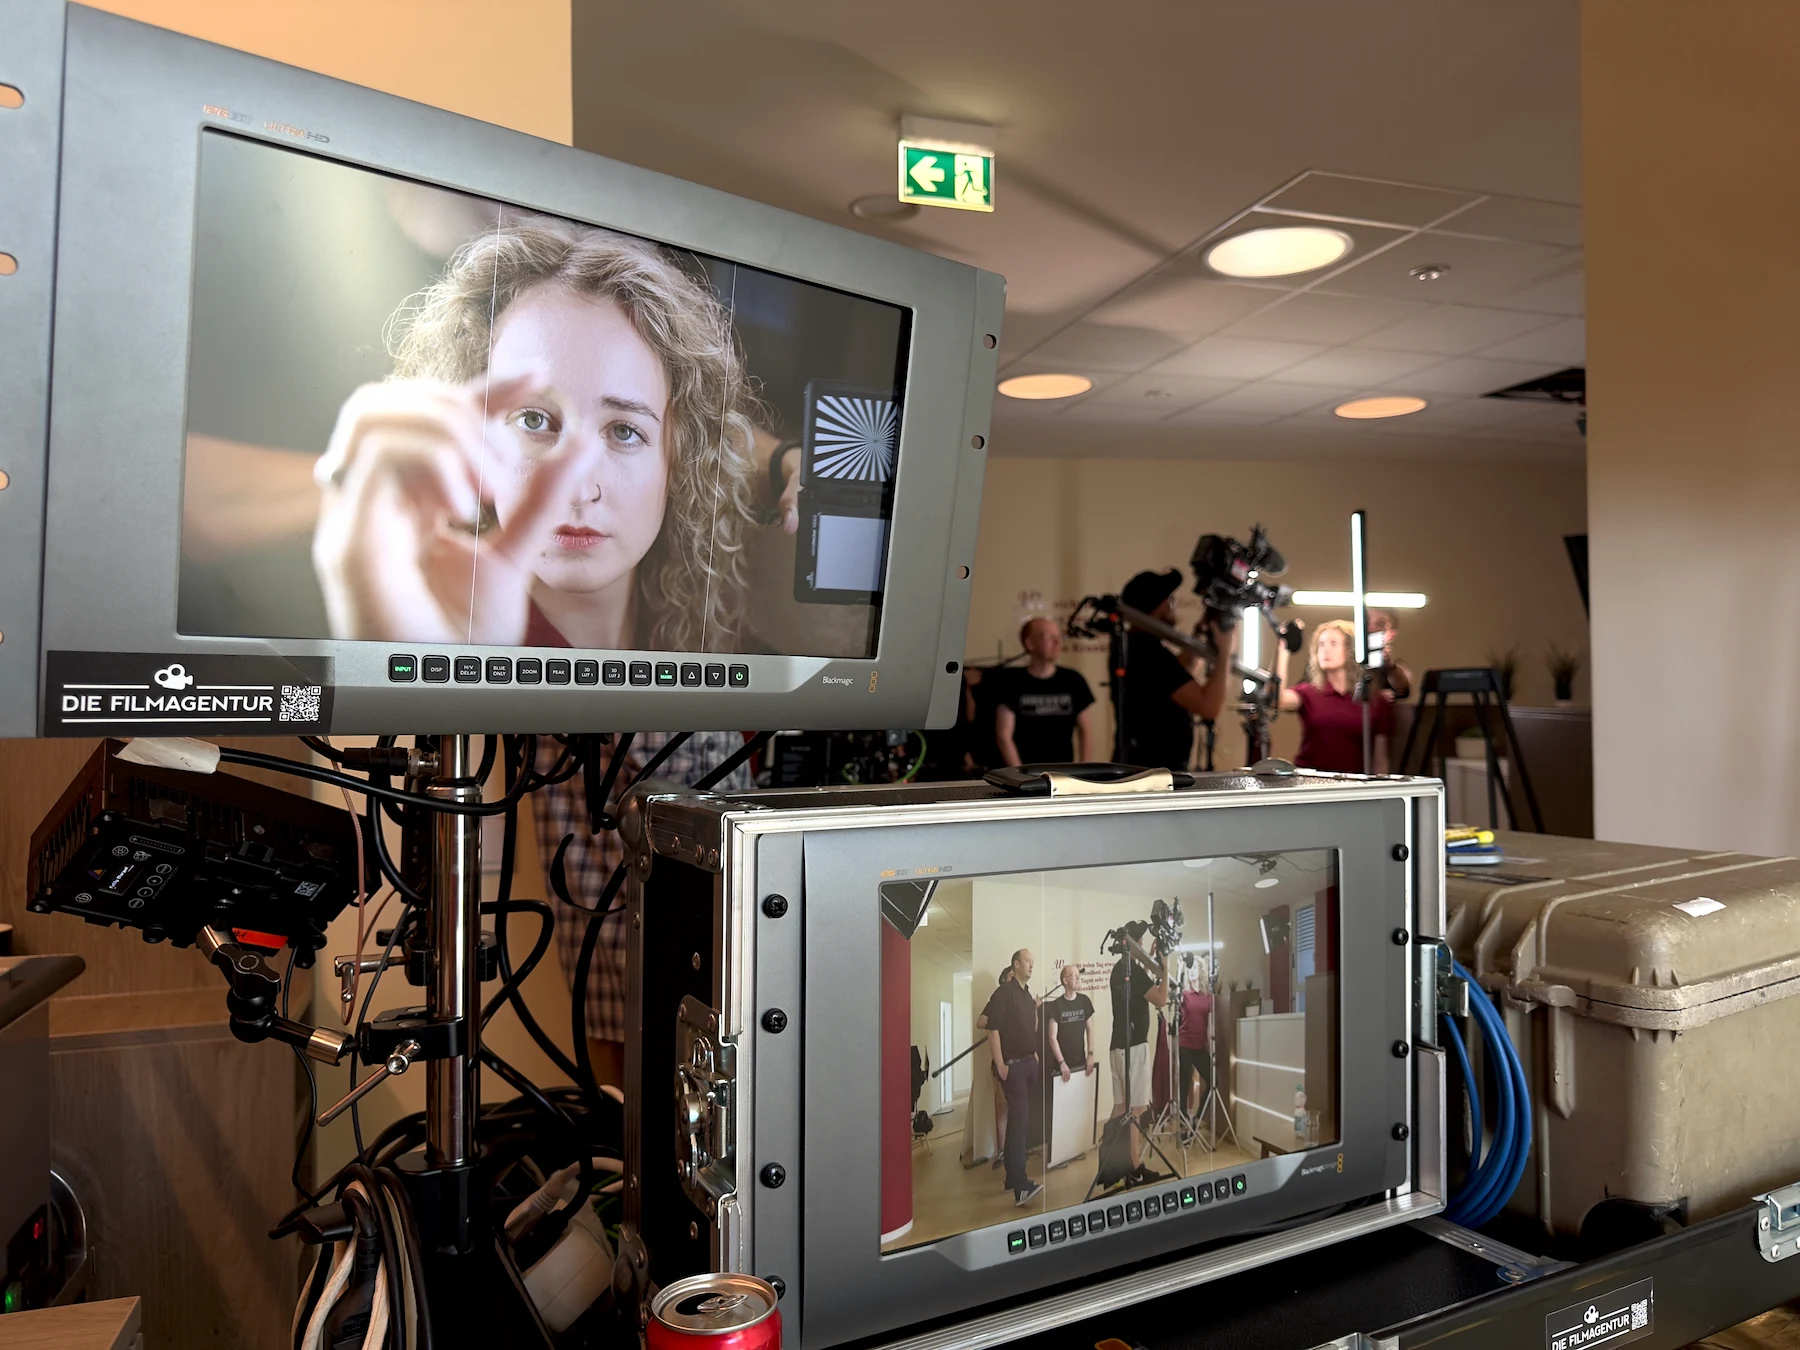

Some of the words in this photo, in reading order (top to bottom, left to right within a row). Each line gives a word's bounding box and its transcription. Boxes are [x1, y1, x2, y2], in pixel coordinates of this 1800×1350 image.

[62, 696, 102, 712] DIE
[110, 696, 274, 712] FILMAGENTUR
[1552, 1338, 1567, 1350] DIE
[1569, 1314, 1630, 1347] FILMAGENTUR
